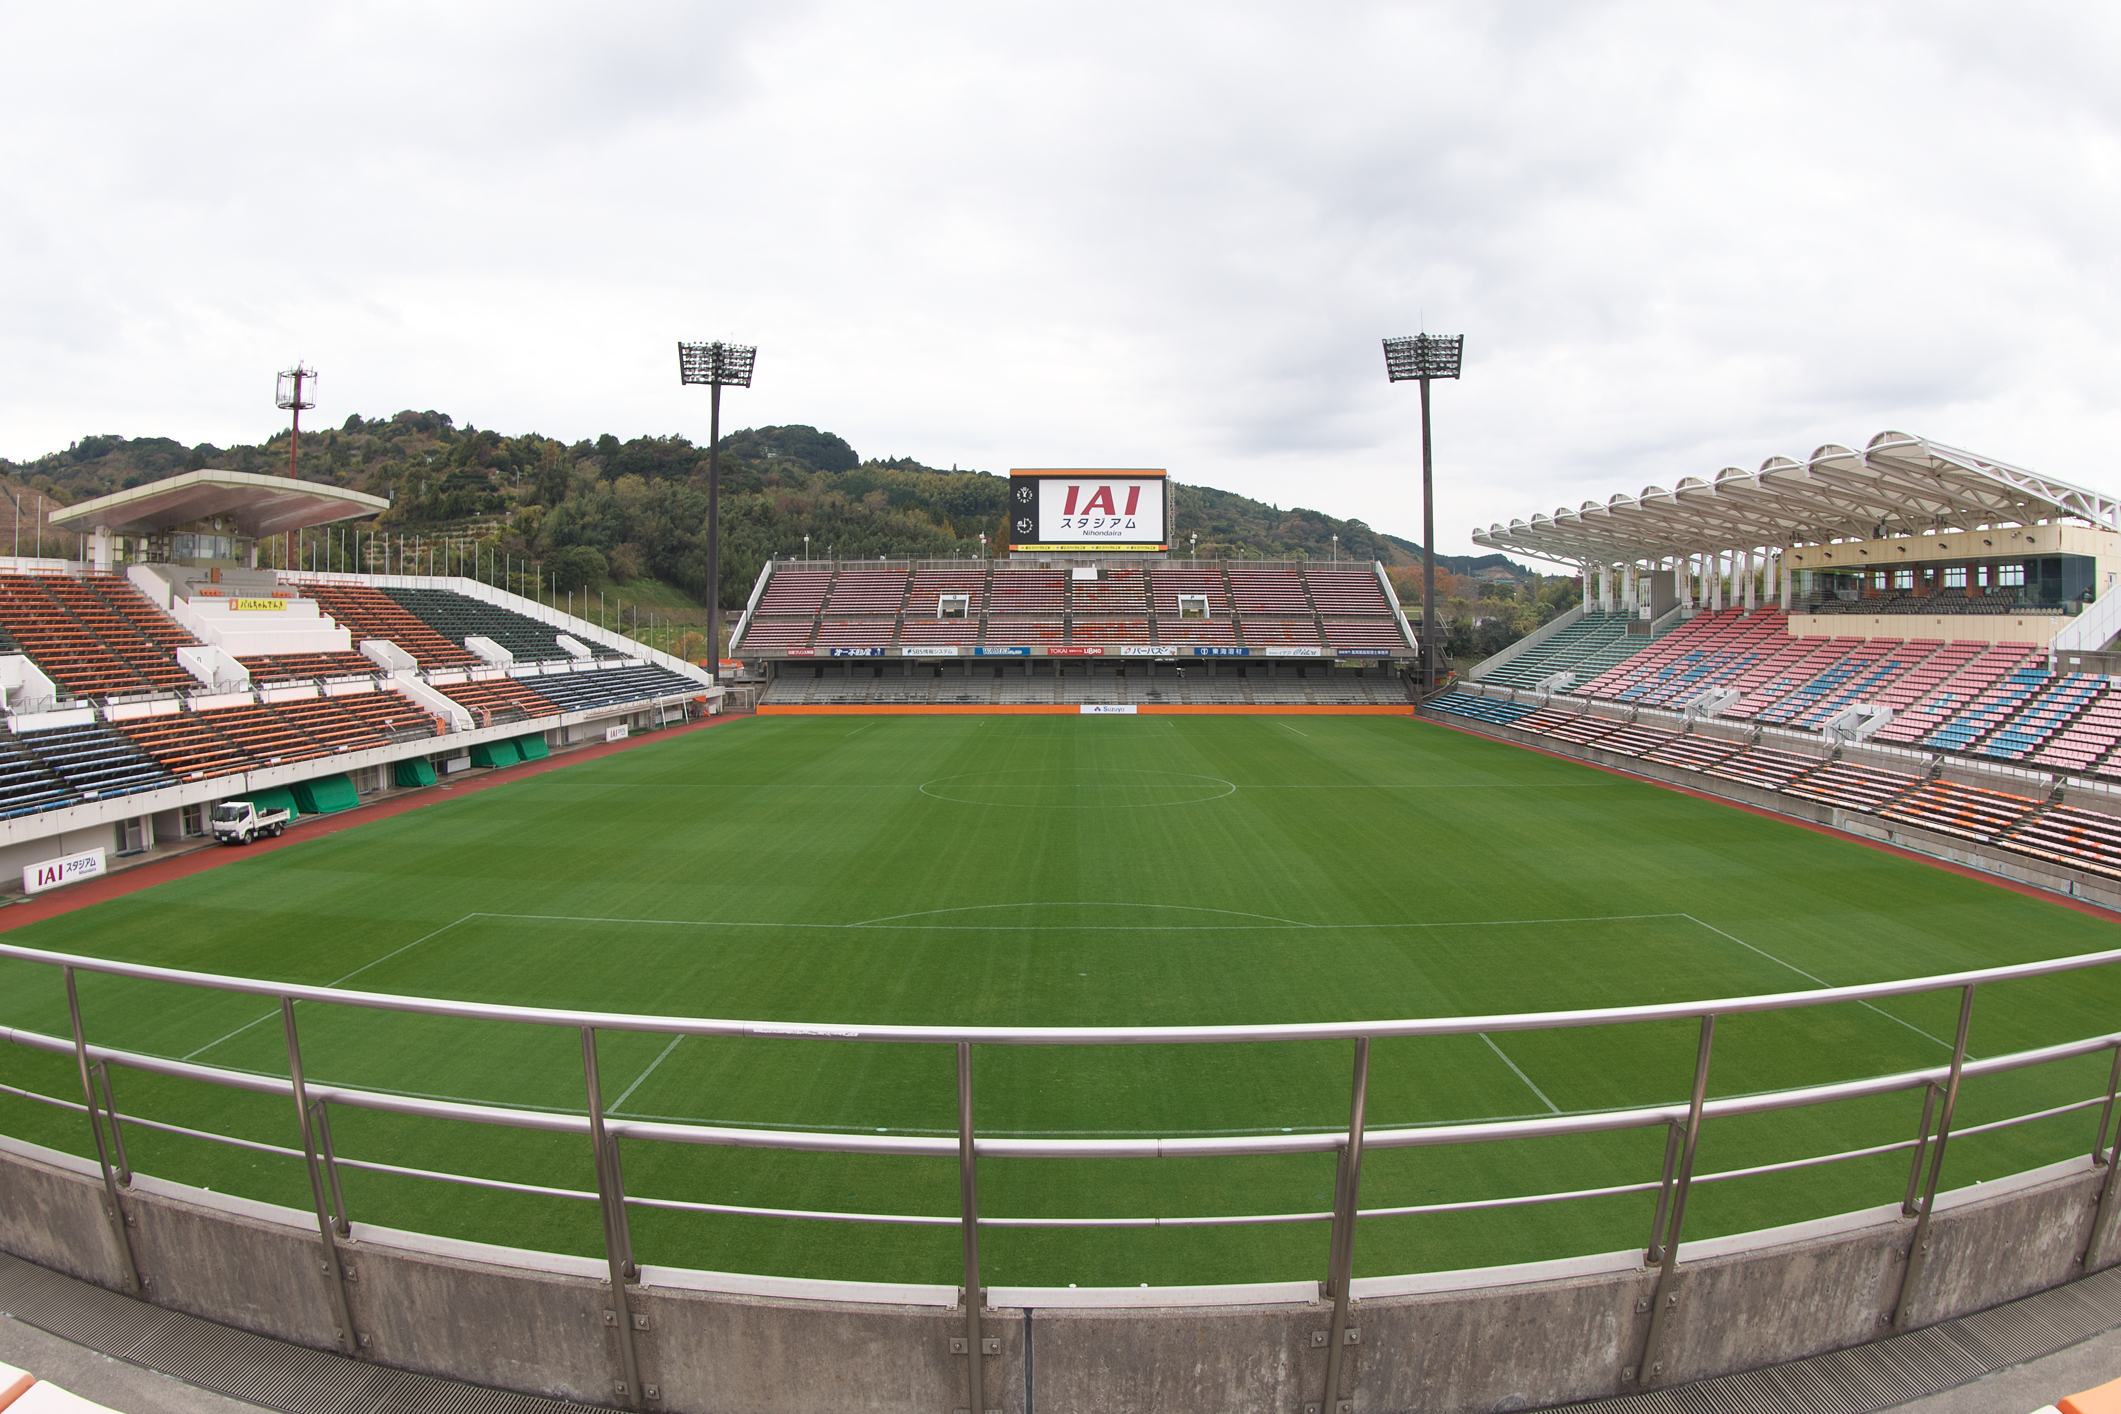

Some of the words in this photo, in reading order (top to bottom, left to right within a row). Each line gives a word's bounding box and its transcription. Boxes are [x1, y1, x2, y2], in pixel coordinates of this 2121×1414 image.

[1063, 485, 1141, 516] IAI
[1060, 518, 1137, 529] スタジアム
[240, 599, 283, 610] パルちゃんでんき
[38, 863, 63, 886] IAI
[66, 857, 97, 873] スタジアム
